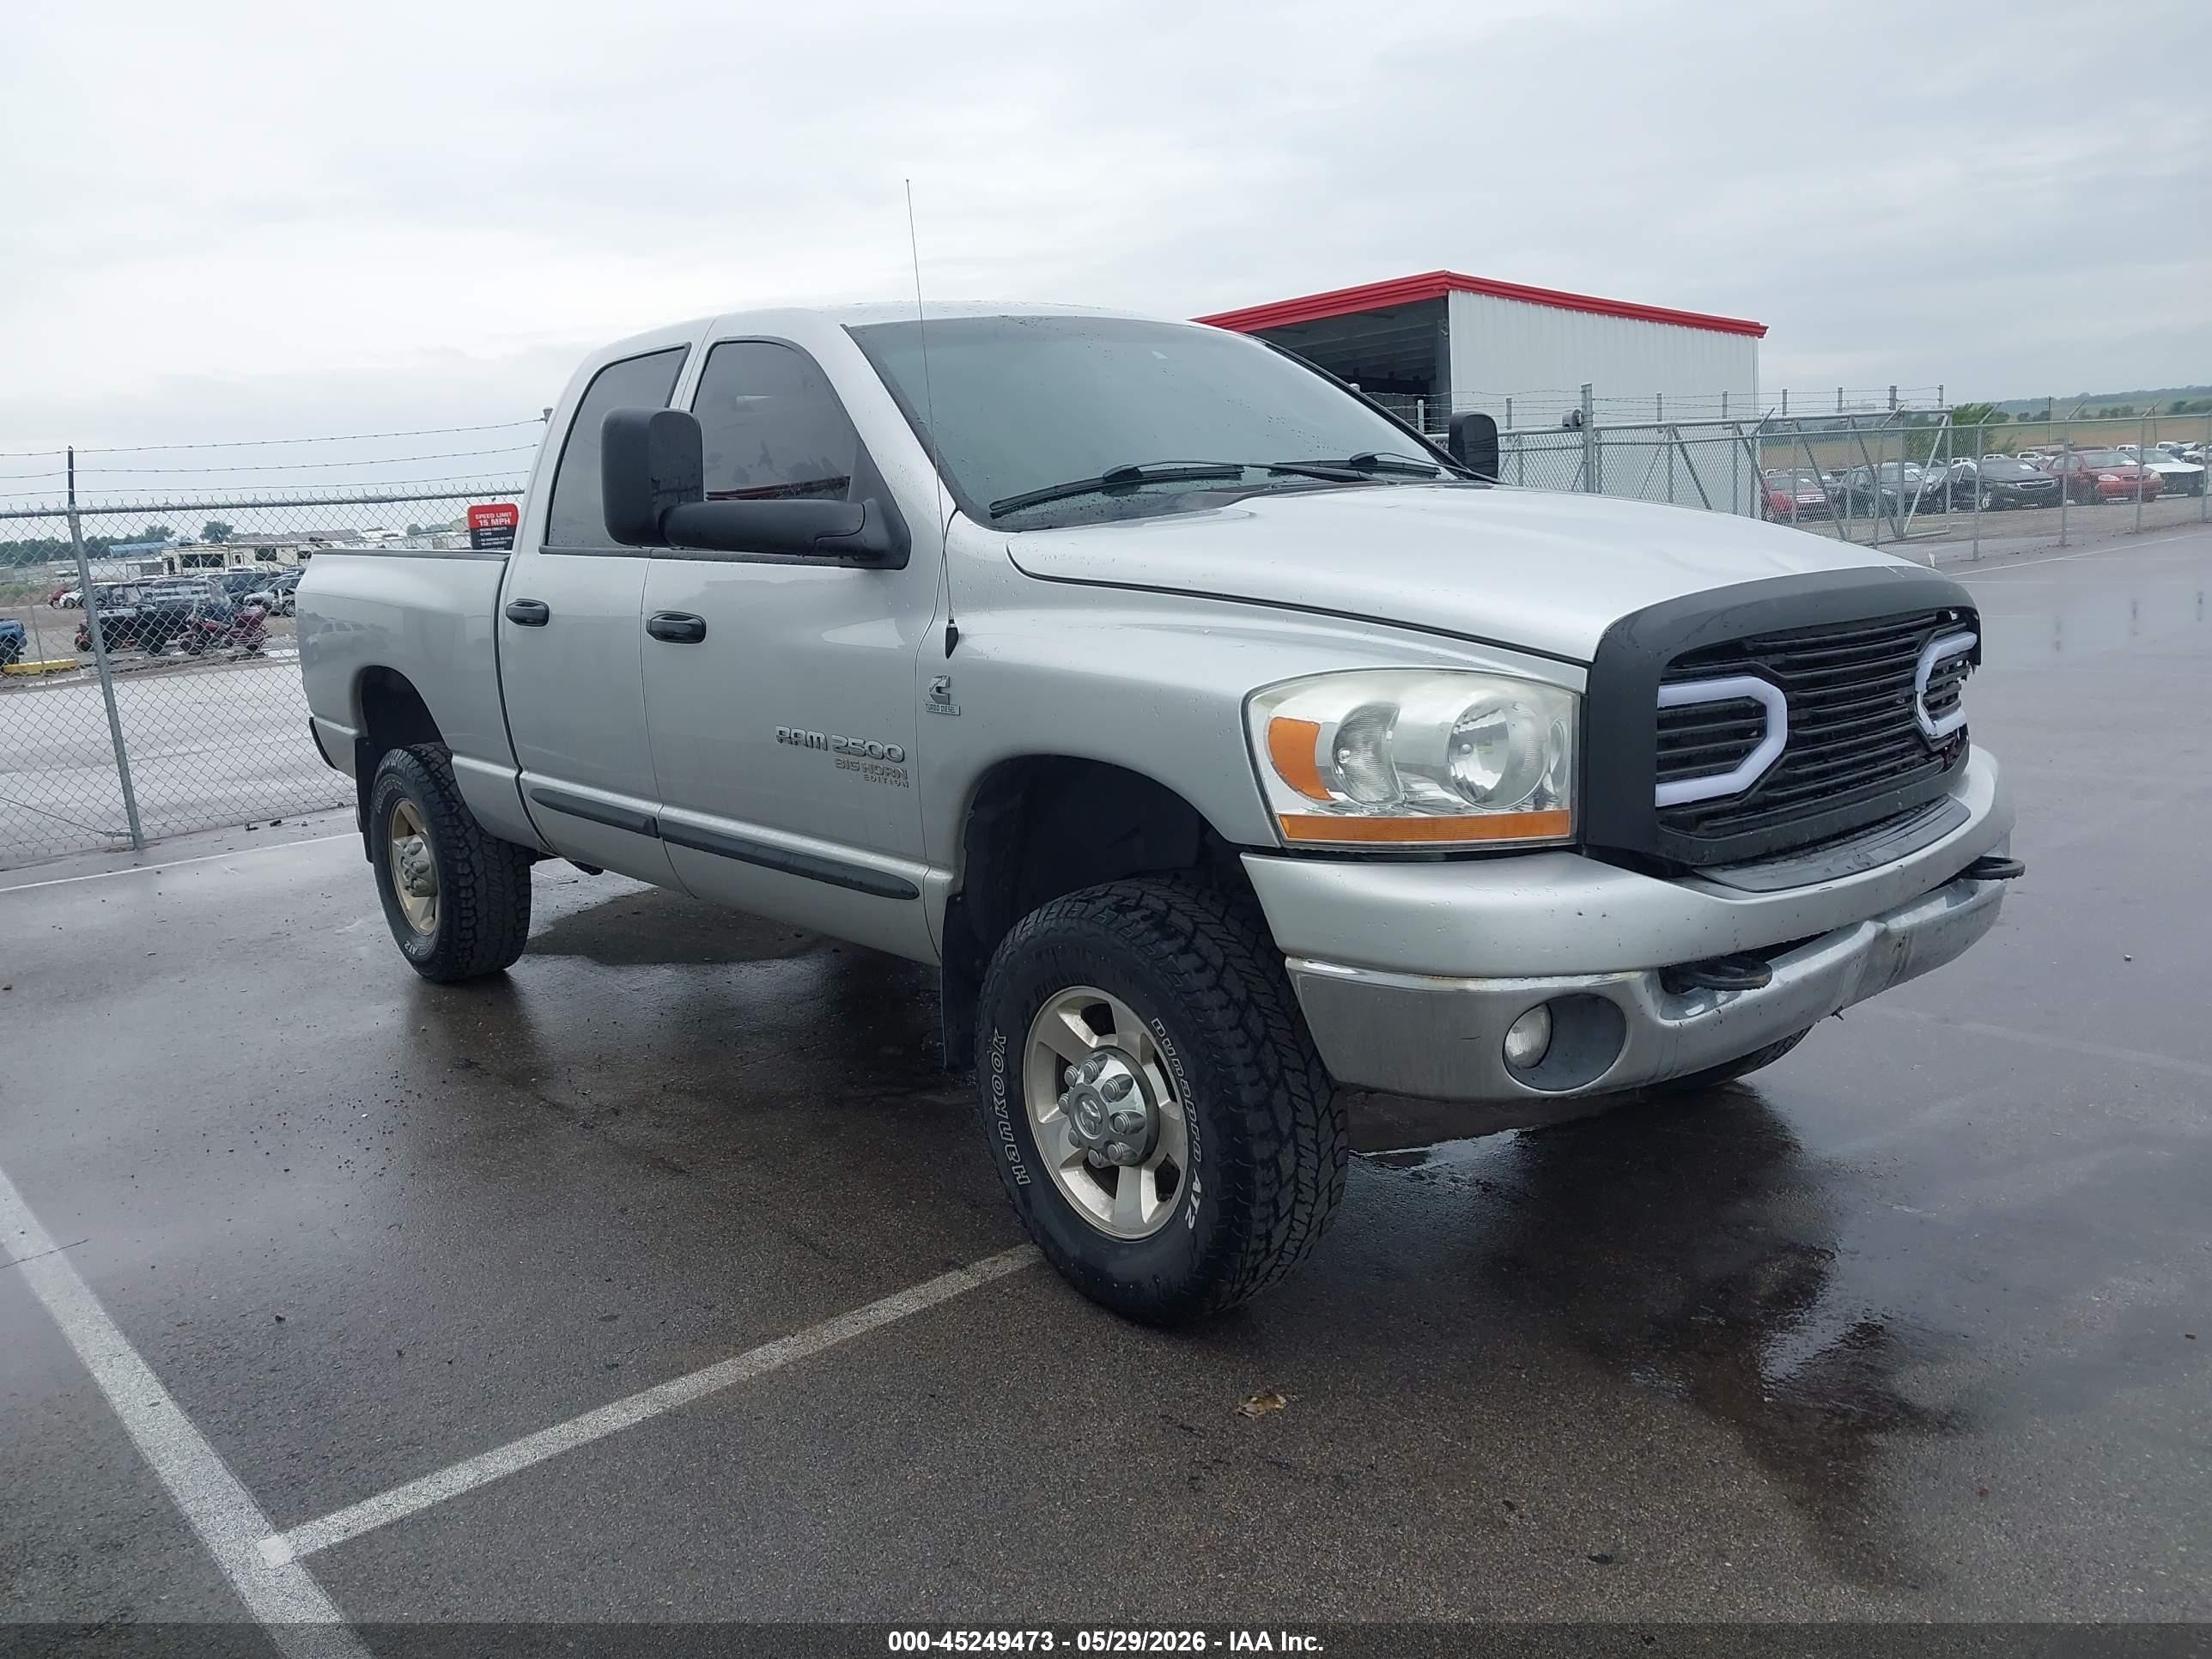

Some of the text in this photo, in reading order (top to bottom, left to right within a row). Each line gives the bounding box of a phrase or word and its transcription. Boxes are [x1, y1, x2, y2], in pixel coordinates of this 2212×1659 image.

[775, 726, 905, 763] RAM 2500
[864, 774, 909, 789] EDITION
[991, 1026, 1031, 1186] Hankook
